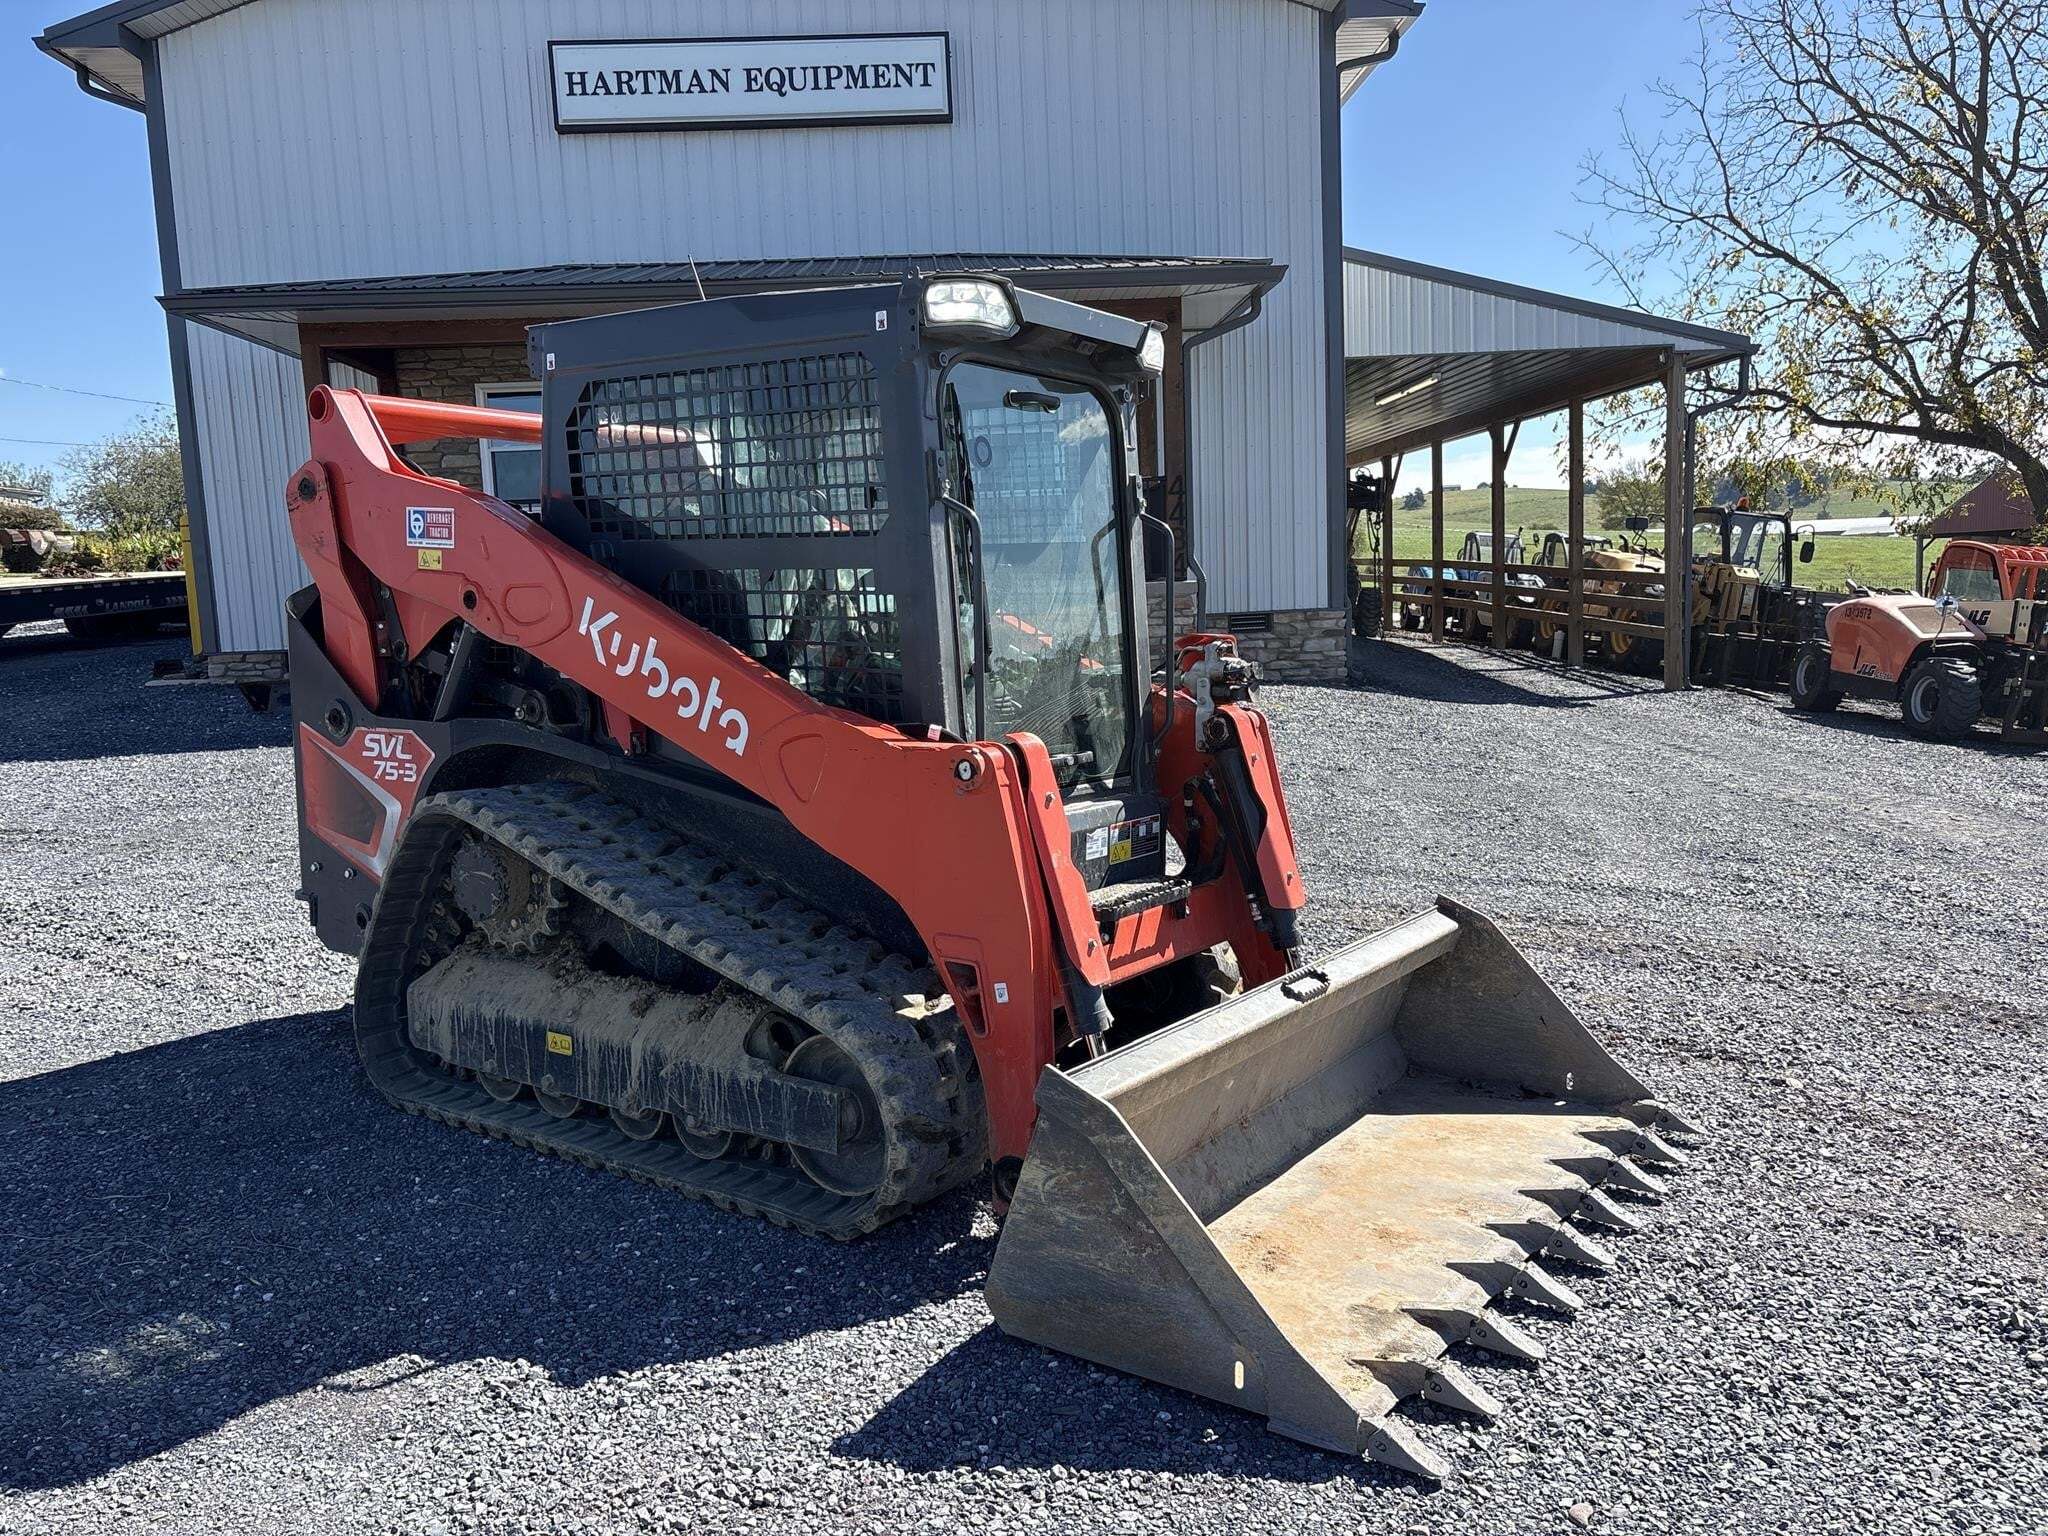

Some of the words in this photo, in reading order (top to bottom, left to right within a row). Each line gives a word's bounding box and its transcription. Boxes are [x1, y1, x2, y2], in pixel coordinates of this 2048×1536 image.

[564, 68, 730, 97] HARTMAN
[743, 62, 936, 98] EQUIPMENT
[427, 512, 451, 524] BEVERAGE
[429, 527, 449, 538] TRACTOR
[1967, 609, 1991, 626] JLG
[578, 596, 749, 757] Kubota
[1857, 663, 1877, 677] JLG
[362, 733, 413, 760] SVL
[373, 760, 417, 782] 75-3
